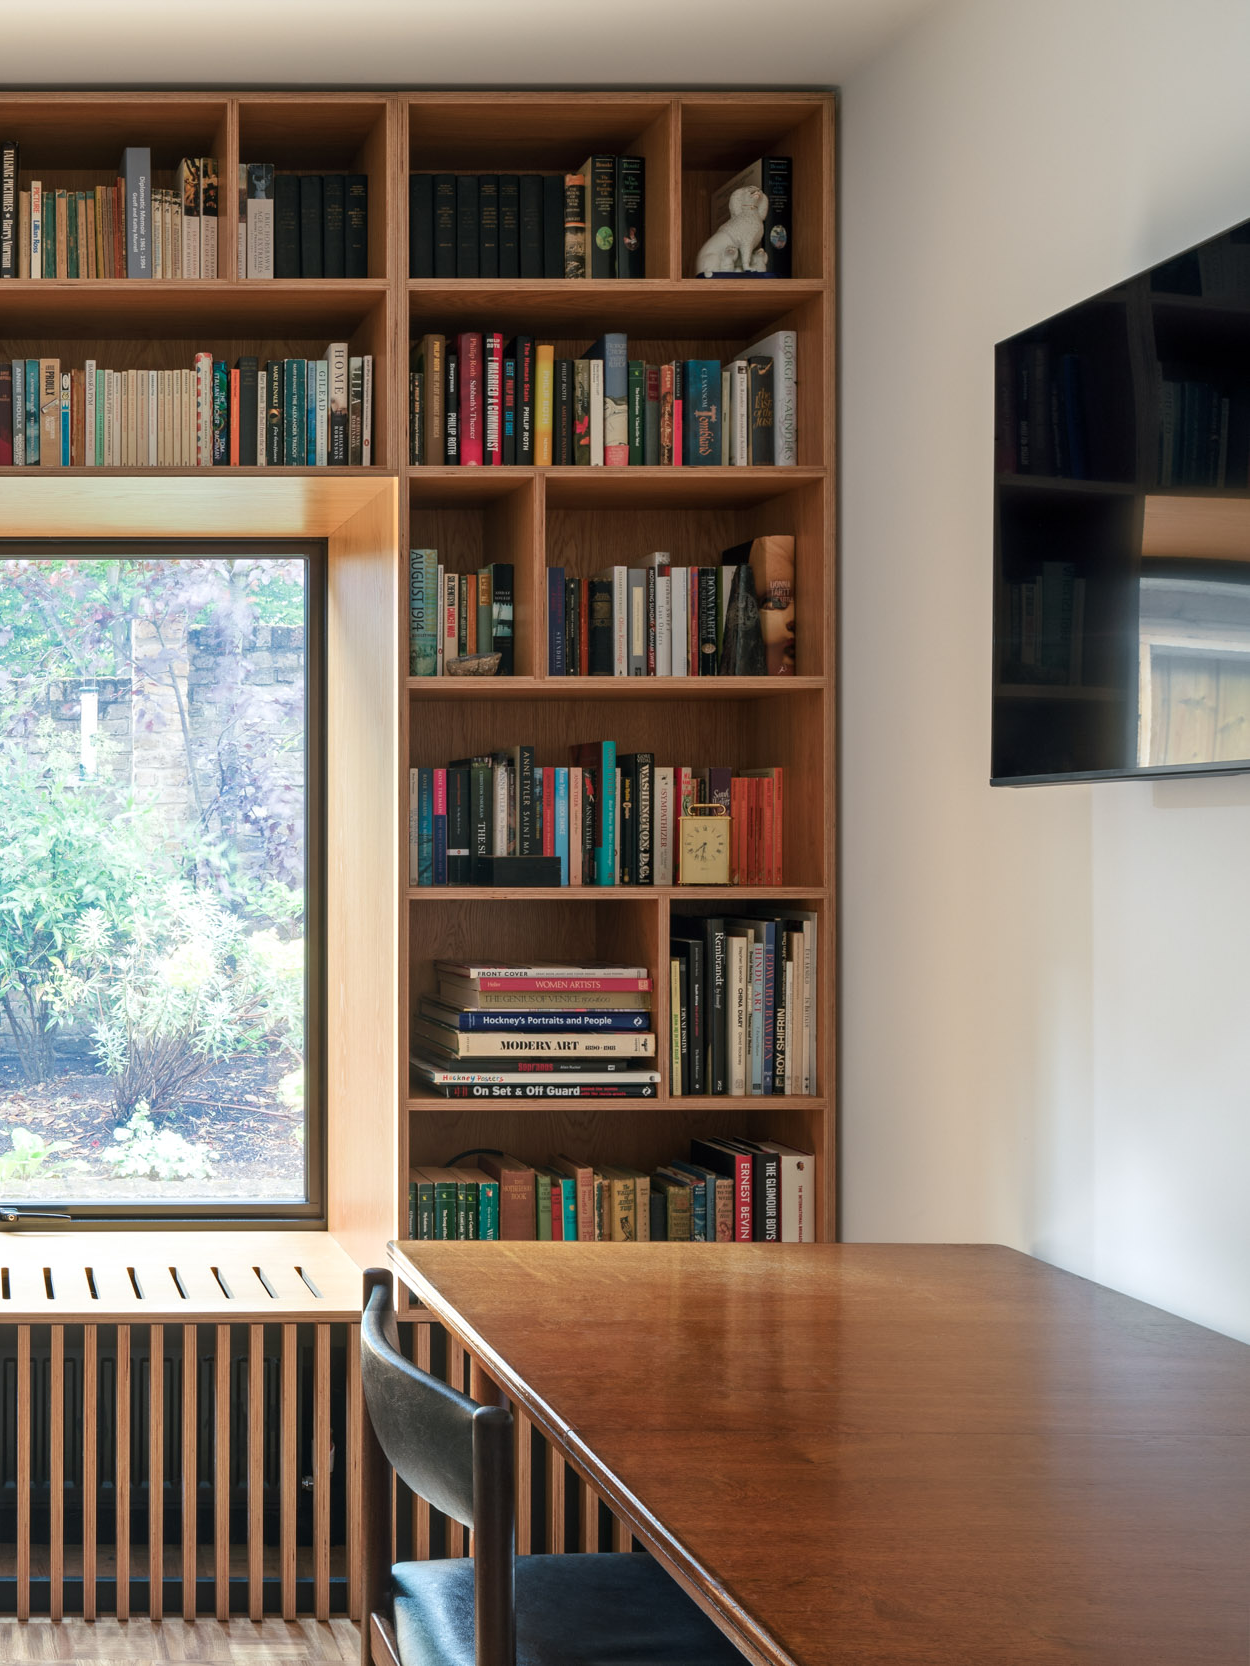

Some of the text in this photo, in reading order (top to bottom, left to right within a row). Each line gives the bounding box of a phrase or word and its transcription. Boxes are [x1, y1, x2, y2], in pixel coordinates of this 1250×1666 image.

[1, 149, 14, 268] TALKING PICTURES Barry Norman
[468, 338, 477, 359] Philip
[45, 371, 55, 396] PROULX
[334, 350, 344, 395] HOME
[351, 371, 361, 405] LILA
[487, 362, 499, 396] MARRIED
[469, 380, 477, 411] Sabbath's
[784, 335, 793, 460] GEORGE SAUNDERS
[447, 413, 457, 436] PHILIP
[469, 412, 477, 439] Theater
[486, 405, 498, 452] COMMUNIST
[694, 405, 717, 456] Tombland
[448, 437, 457, 455] ROTH
[411, 551, 424, 632] AUGUST 1914
[707, 575, 715, 640] DONNA TARTT
[660, 791, 668, 848] SYMPATHIZER
[714, 932, 724, 986] Rembrandt
[535, 980, 568, 988] WOMEN
[570, 980, 601, 989] ARTISTS
[754, 990, 762, 1013] ART
[765, 954, 774, 1060] EDWARD BAWDEN
[483, 1016, 526, 1026] Hockney's
[527, 1016, 564, 1024] Portraits
[584, 1017, 612, 1026] People
[500, 1041, 579, 1050] MODERN ART
[443, 1074, 504, 1083] Hockney Posters
[518, 1062, 554, 1072] Sopranos
[776, 1053, 785, 1075] ROY
[473, 1086, 580, 1096] On Set & Off Guard
[741, 1163, 750, 1239] ERNEST BEVIN
[766, 1162, 776, 1240] THE GLAMOUR BOYS
